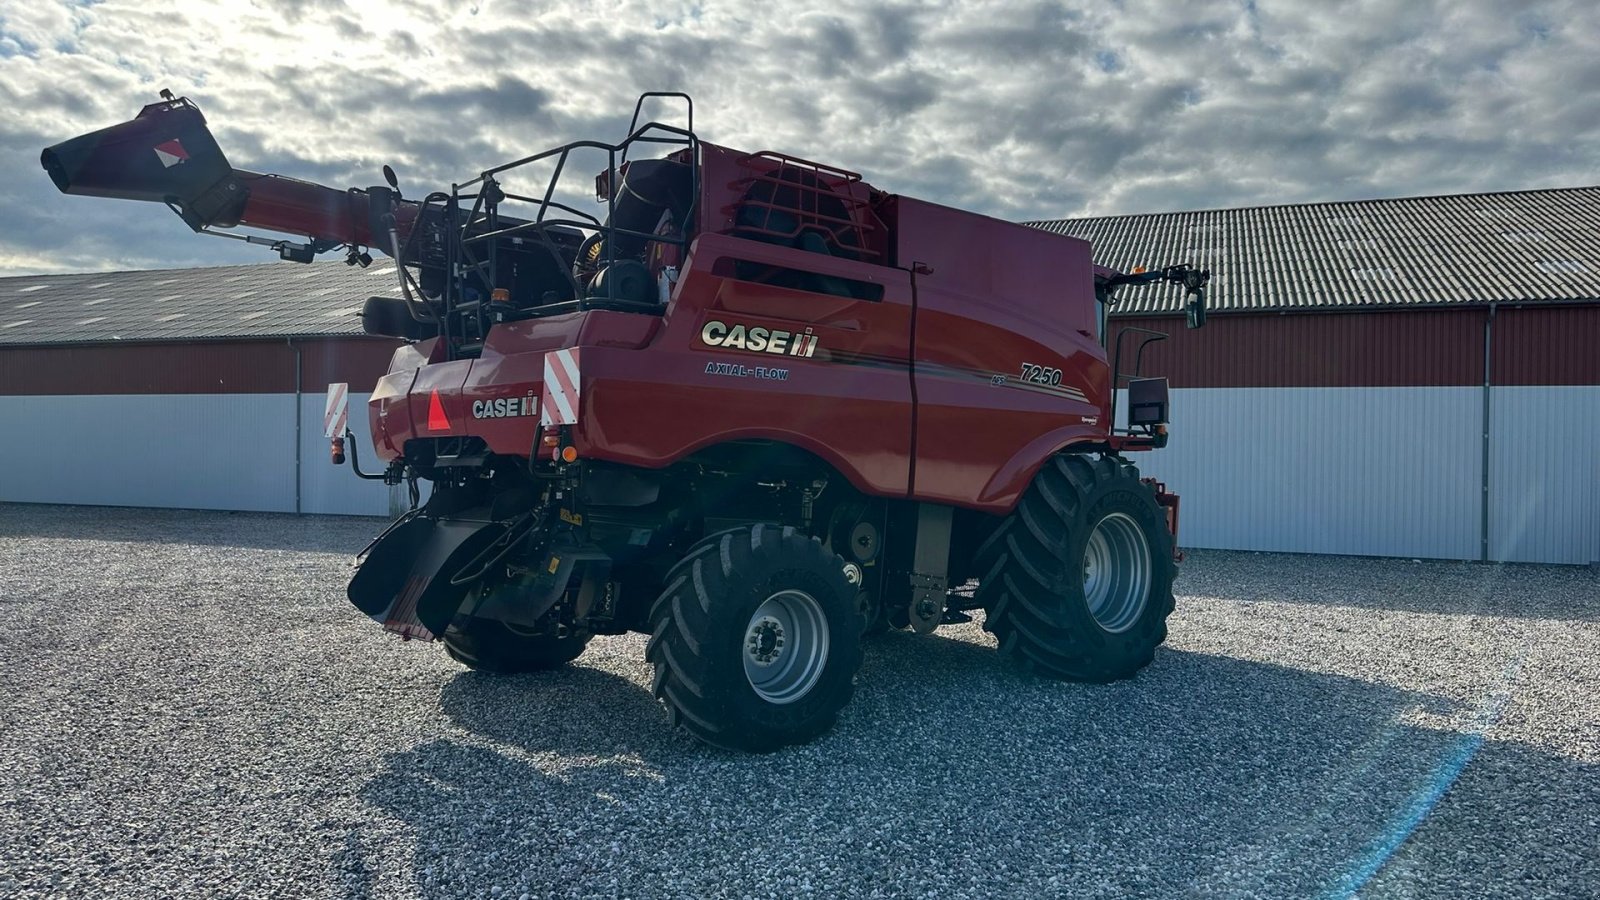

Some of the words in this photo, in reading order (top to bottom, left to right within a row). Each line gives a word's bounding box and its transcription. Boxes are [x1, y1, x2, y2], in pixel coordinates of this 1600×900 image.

[703, 321, 789, 354] CASE
[705, 362, 789, 381] AXIAL-FLOW
[1021, 362, 1063, 387] 7250
[473, 398, 518, 419] CASE
